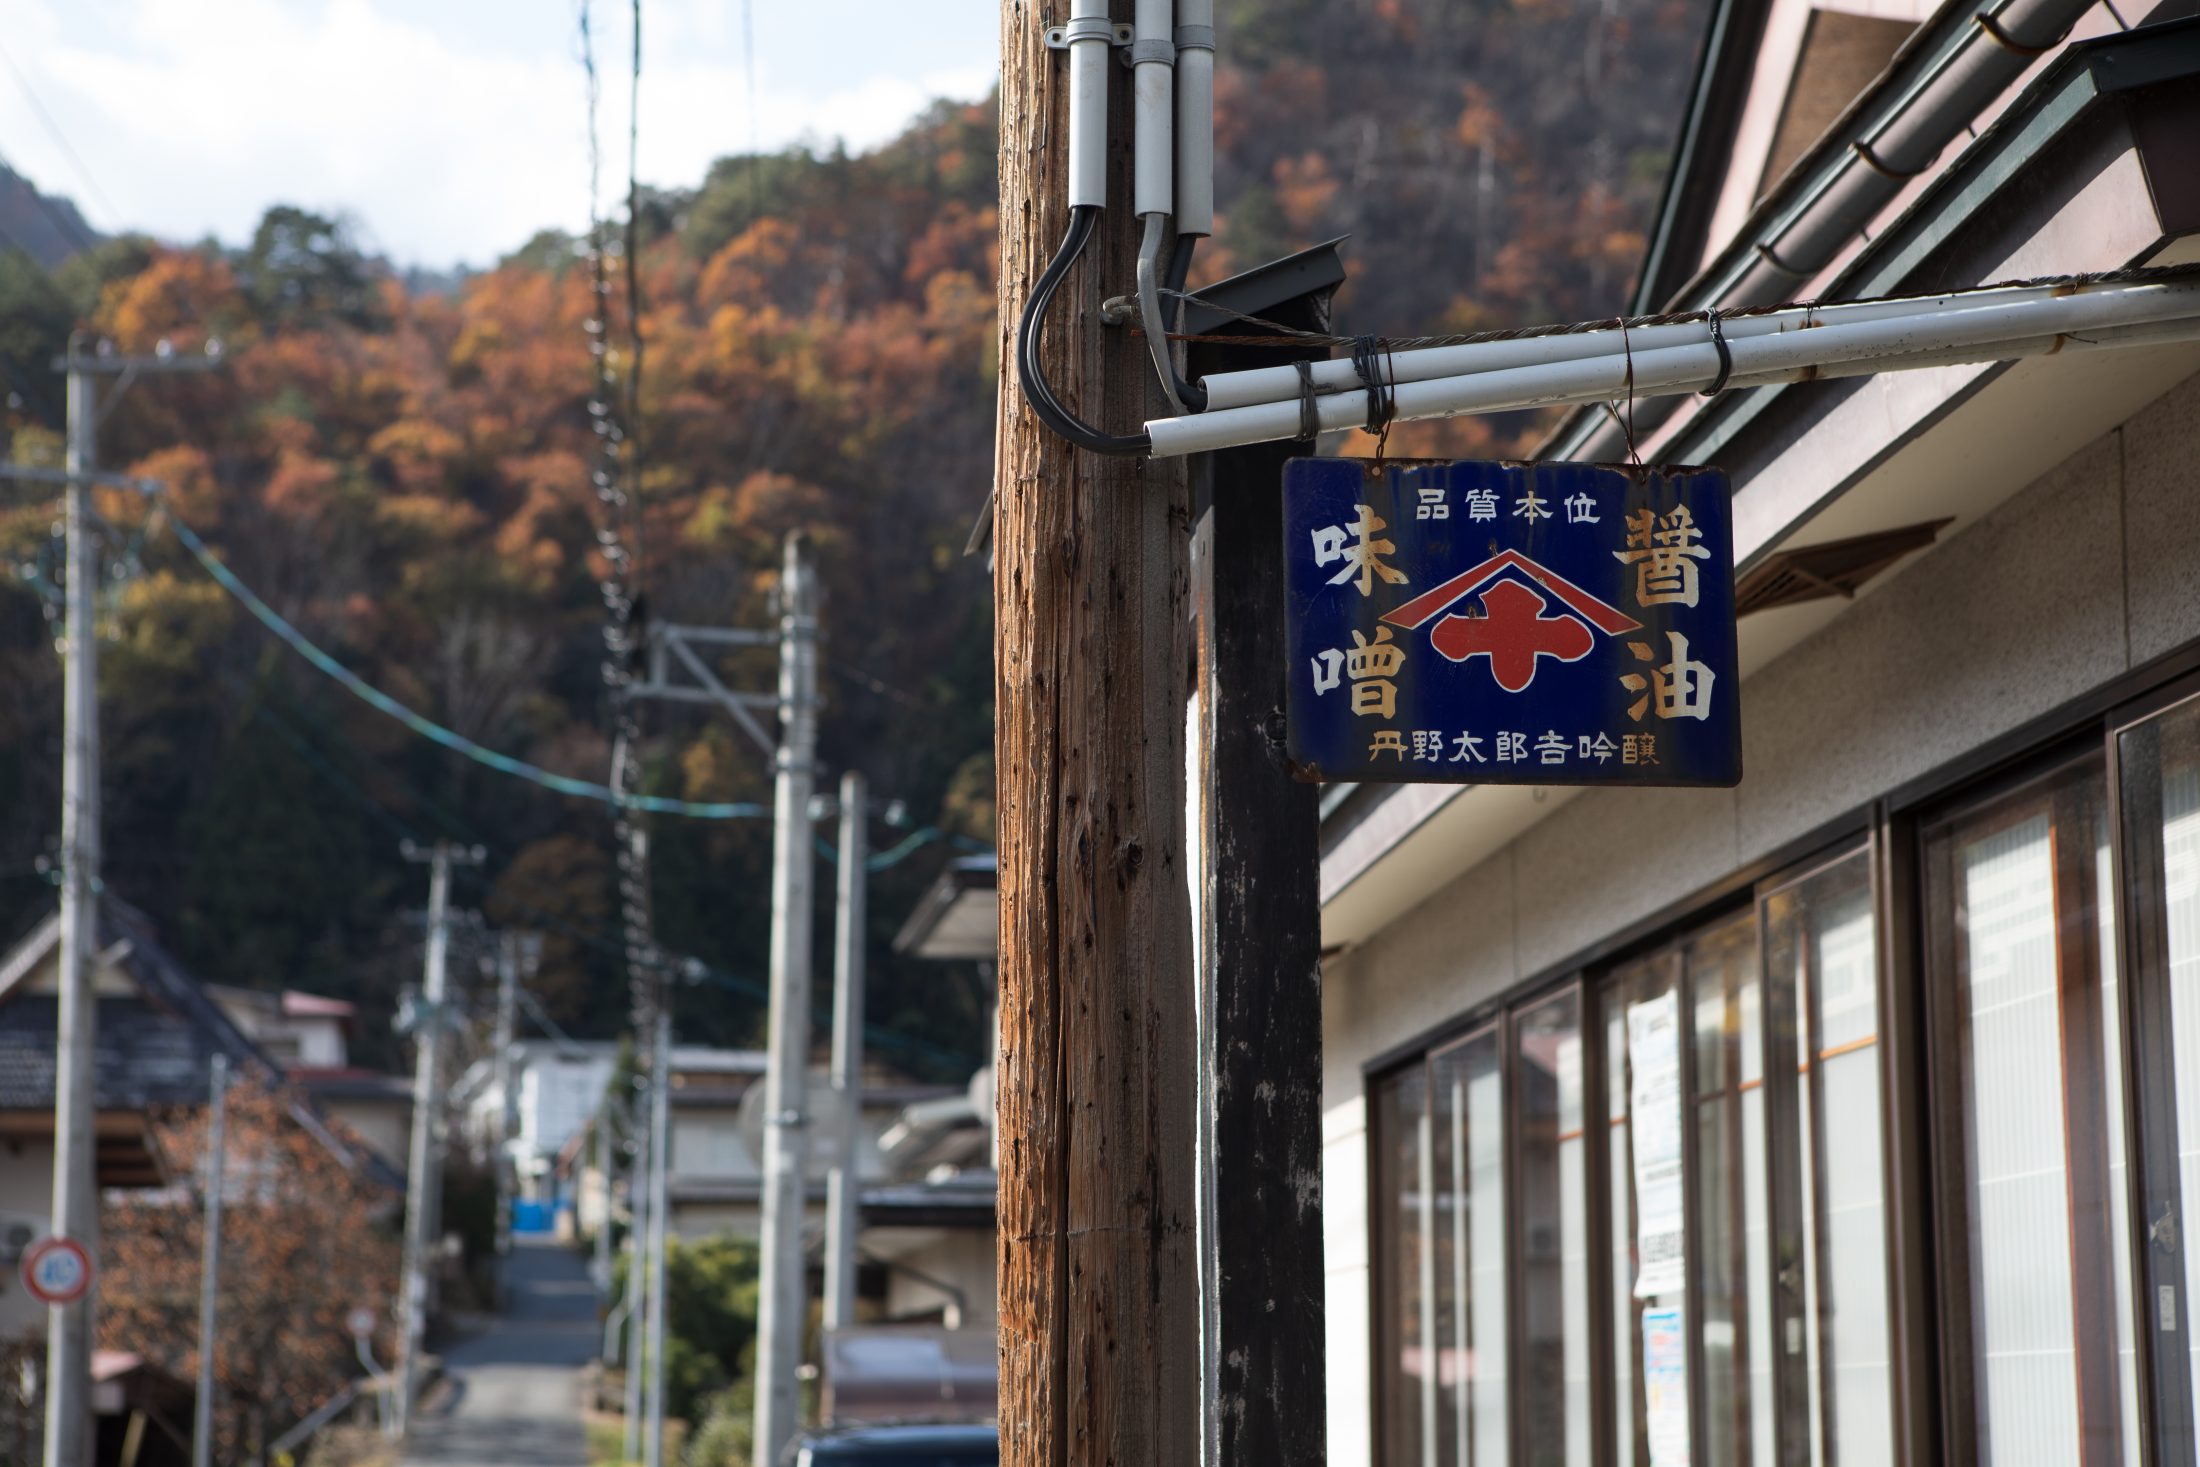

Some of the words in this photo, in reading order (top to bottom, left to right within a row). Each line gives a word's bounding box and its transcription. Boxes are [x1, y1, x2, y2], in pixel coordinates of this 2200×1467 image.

[1416, 488, 1601, 526] 品質本位
[1310, 503, 1409, 720] 味噌
